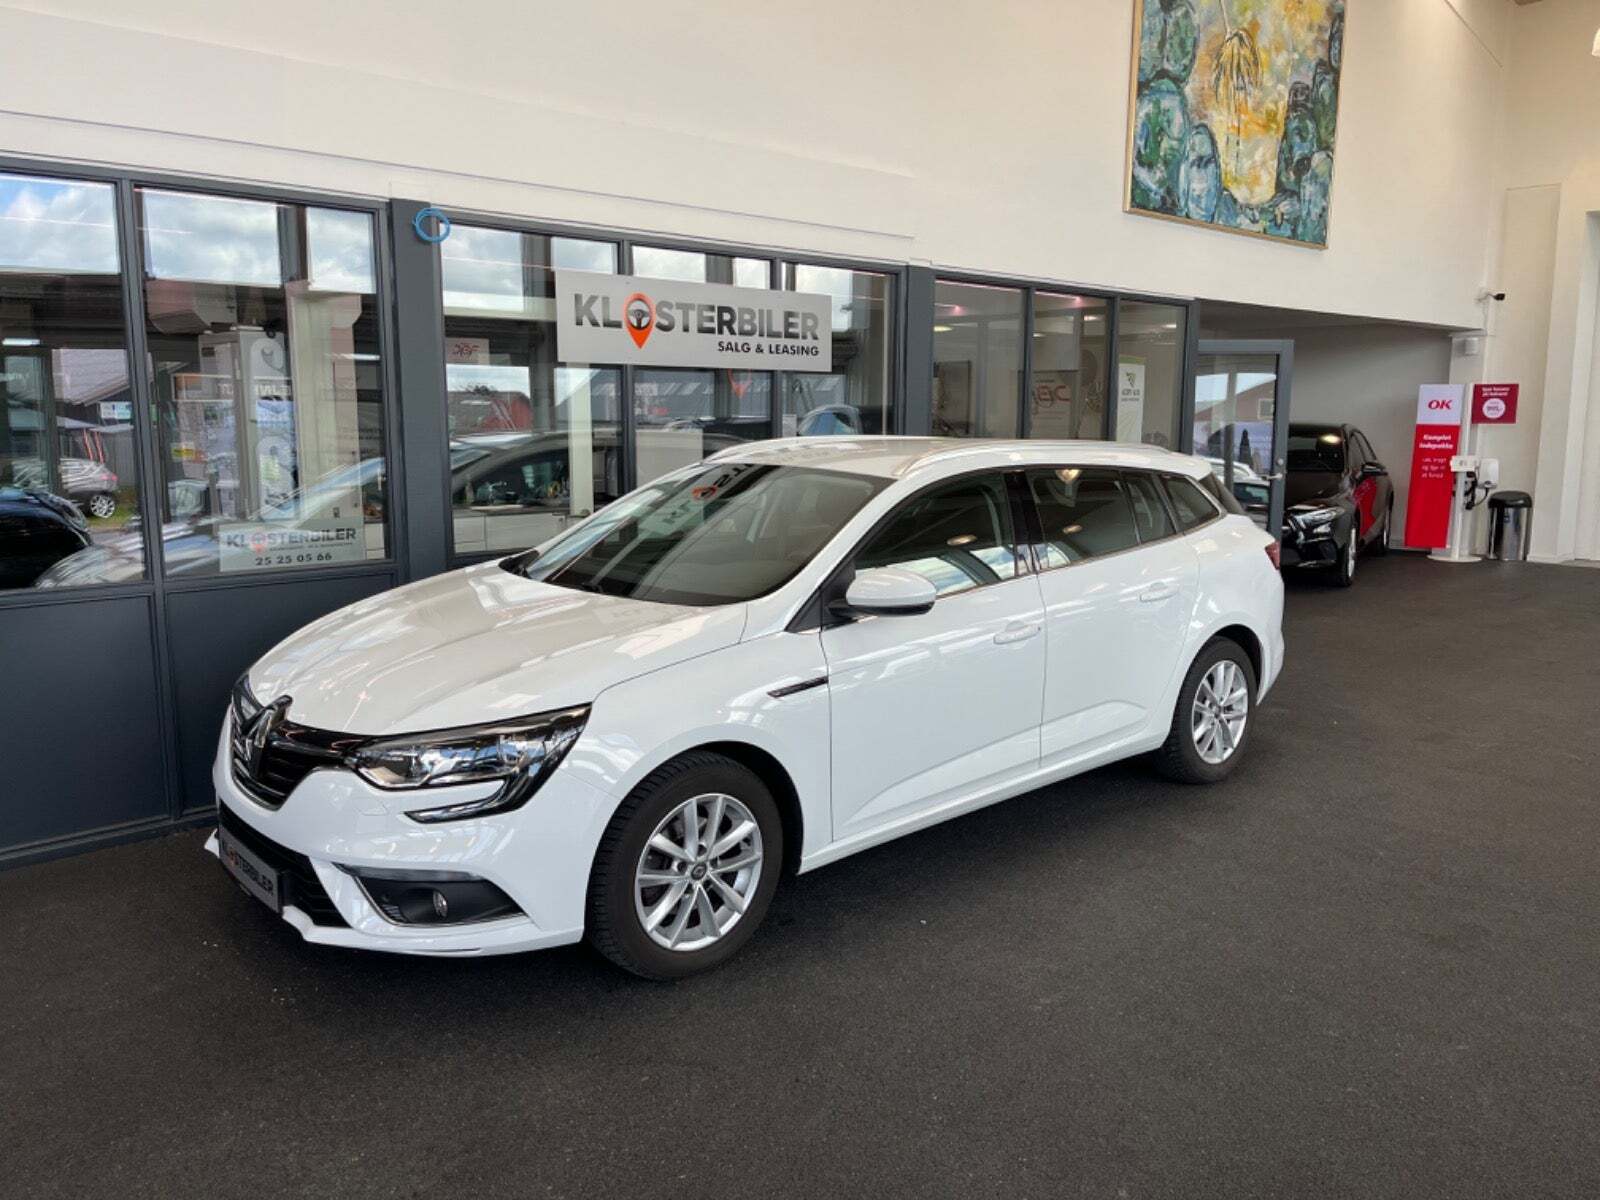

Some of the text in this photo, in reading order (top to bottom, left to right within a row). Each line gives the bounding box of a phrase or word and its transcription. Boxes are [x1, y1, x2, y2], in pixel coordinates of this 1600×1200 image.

[574, 293, 819, 343] KLOSTERBILER
[718, 340, 819, 357] SALG & LEASING
[1428, 399, 1452, 410] OK
[227, 527, 356, 549] KLOSTERBILER
[255, 552, 332, 566] 25 25 05 66
